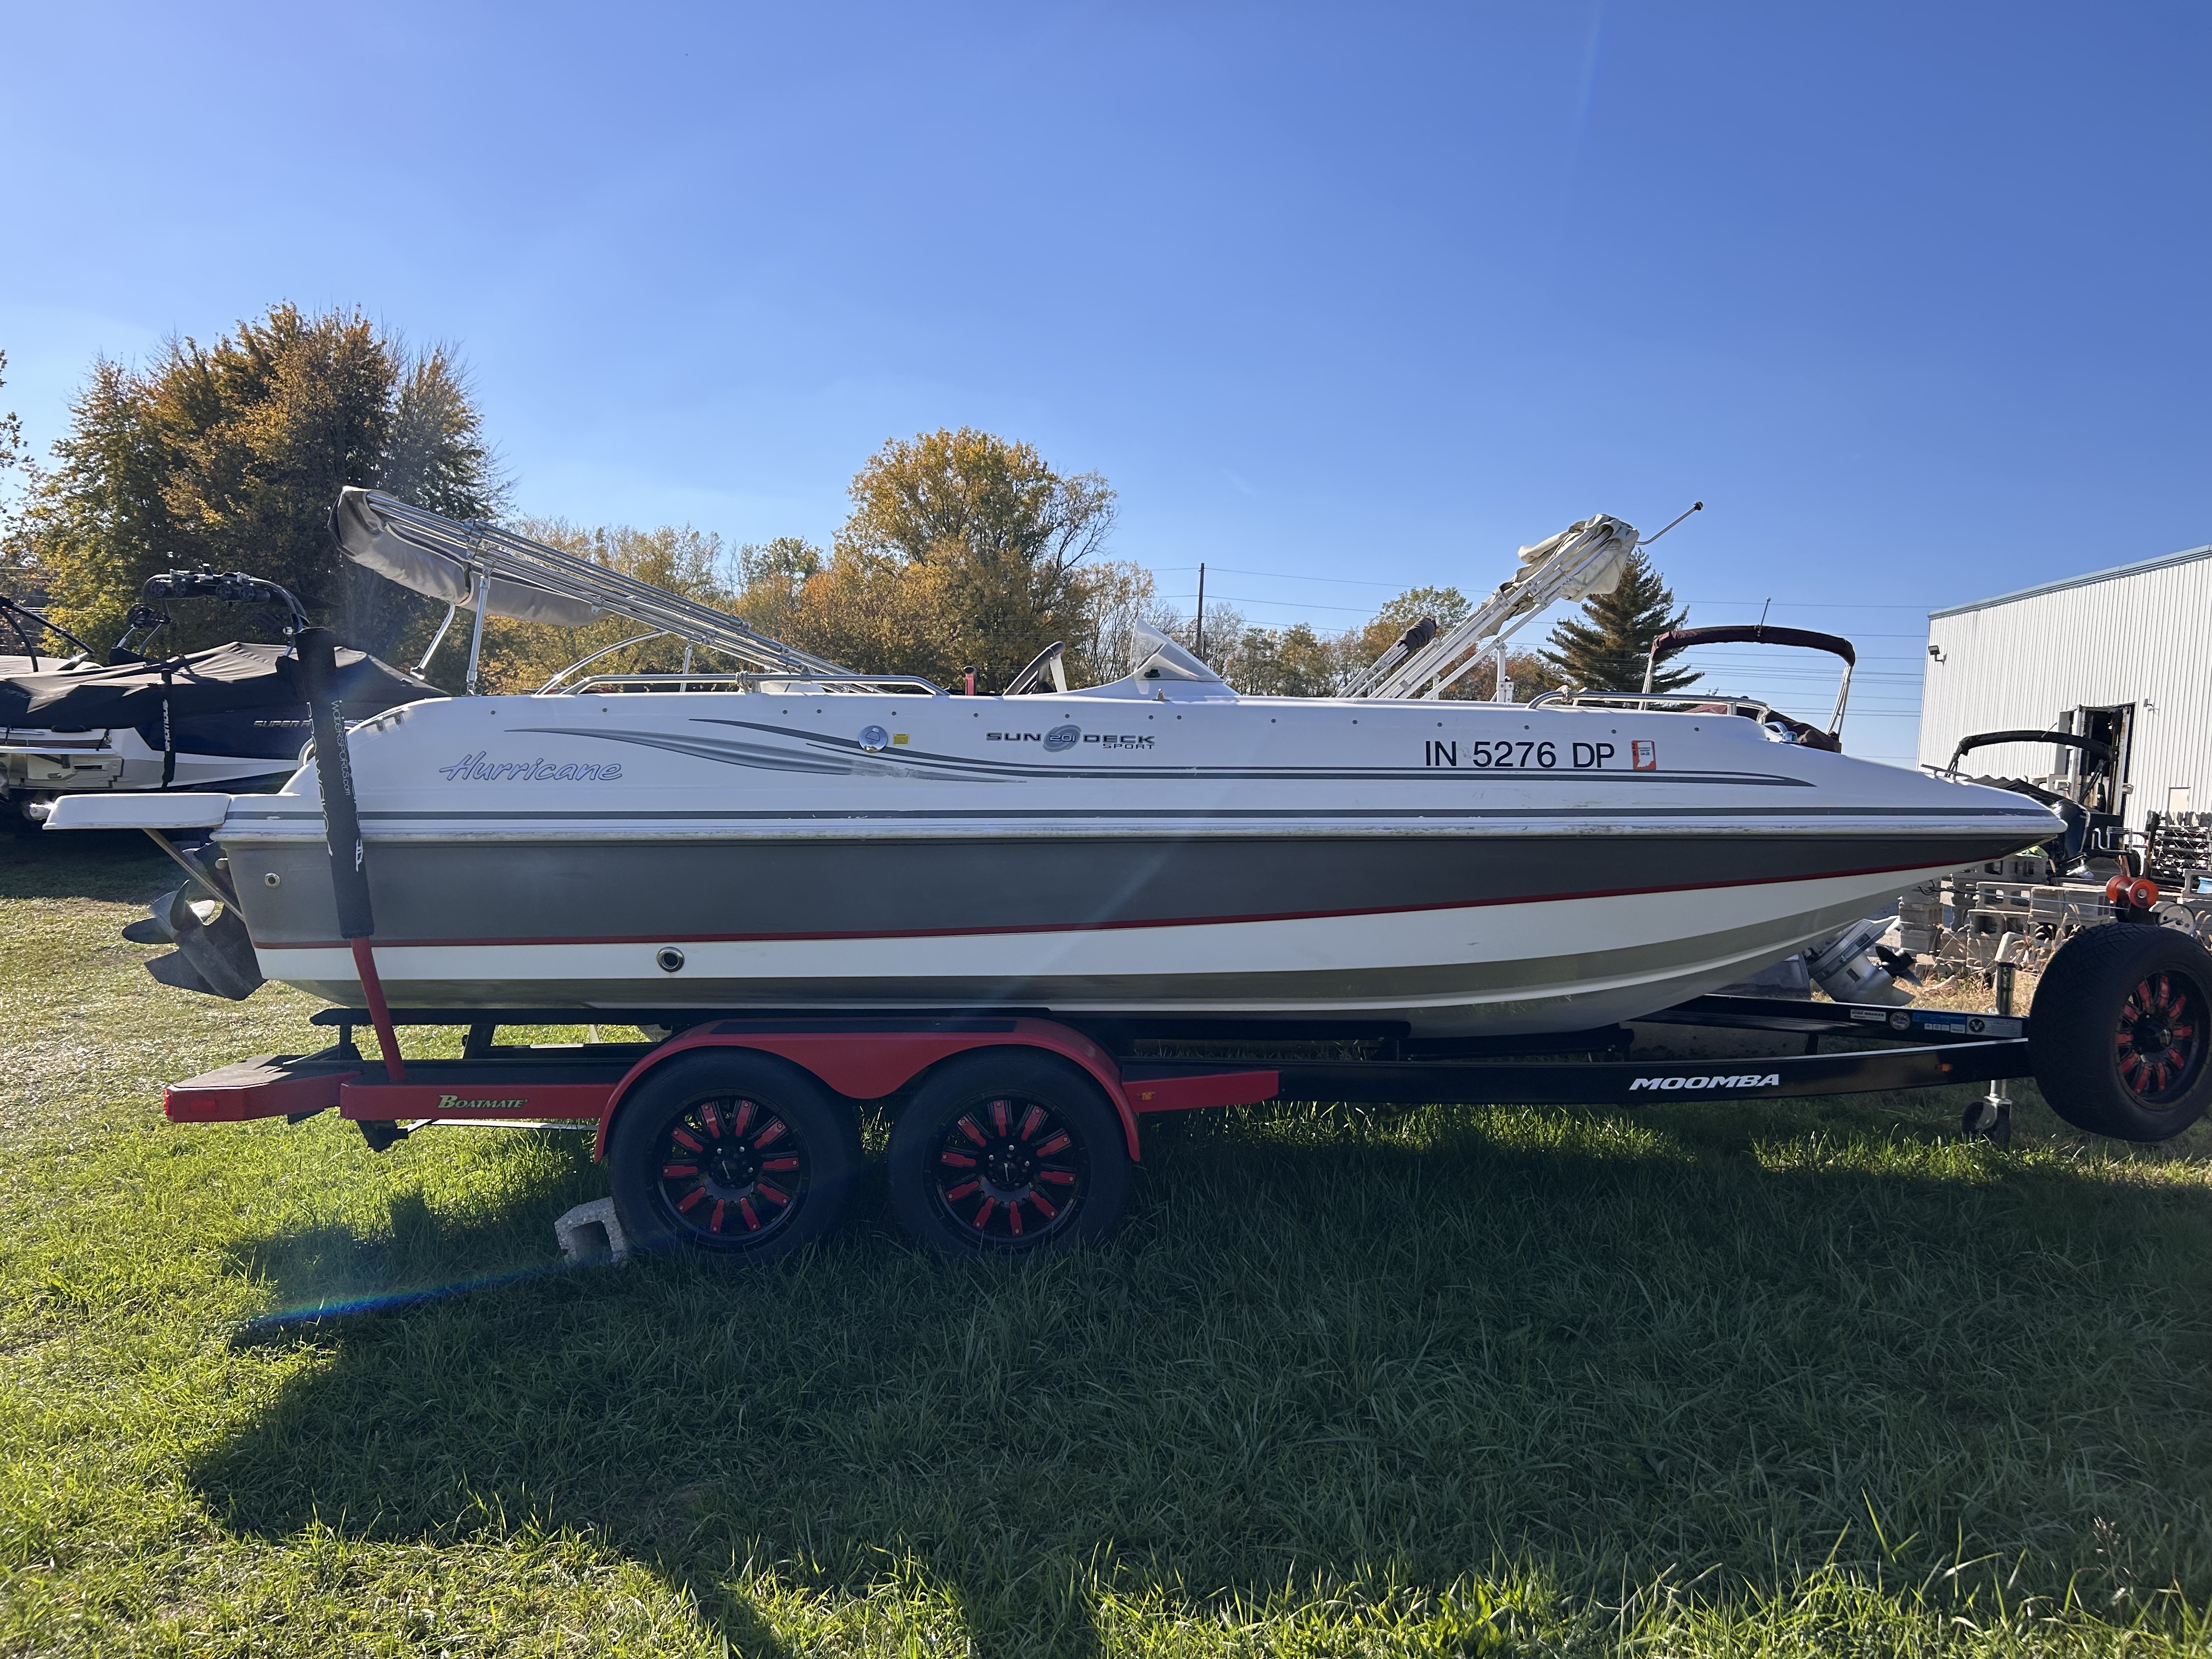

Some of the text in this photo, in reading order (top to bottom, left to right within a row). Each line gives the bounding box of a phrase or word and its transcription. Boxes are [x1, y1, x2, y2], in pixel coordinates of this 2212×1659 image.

[986, 732, 1155, 744] SUN 201 DECK
[1426, 741, 1615, 768] IN 5276 DP
[439, 751, 623, 781] Hurricane
[1629, 1074, 1779, 1090] MOOMBA
